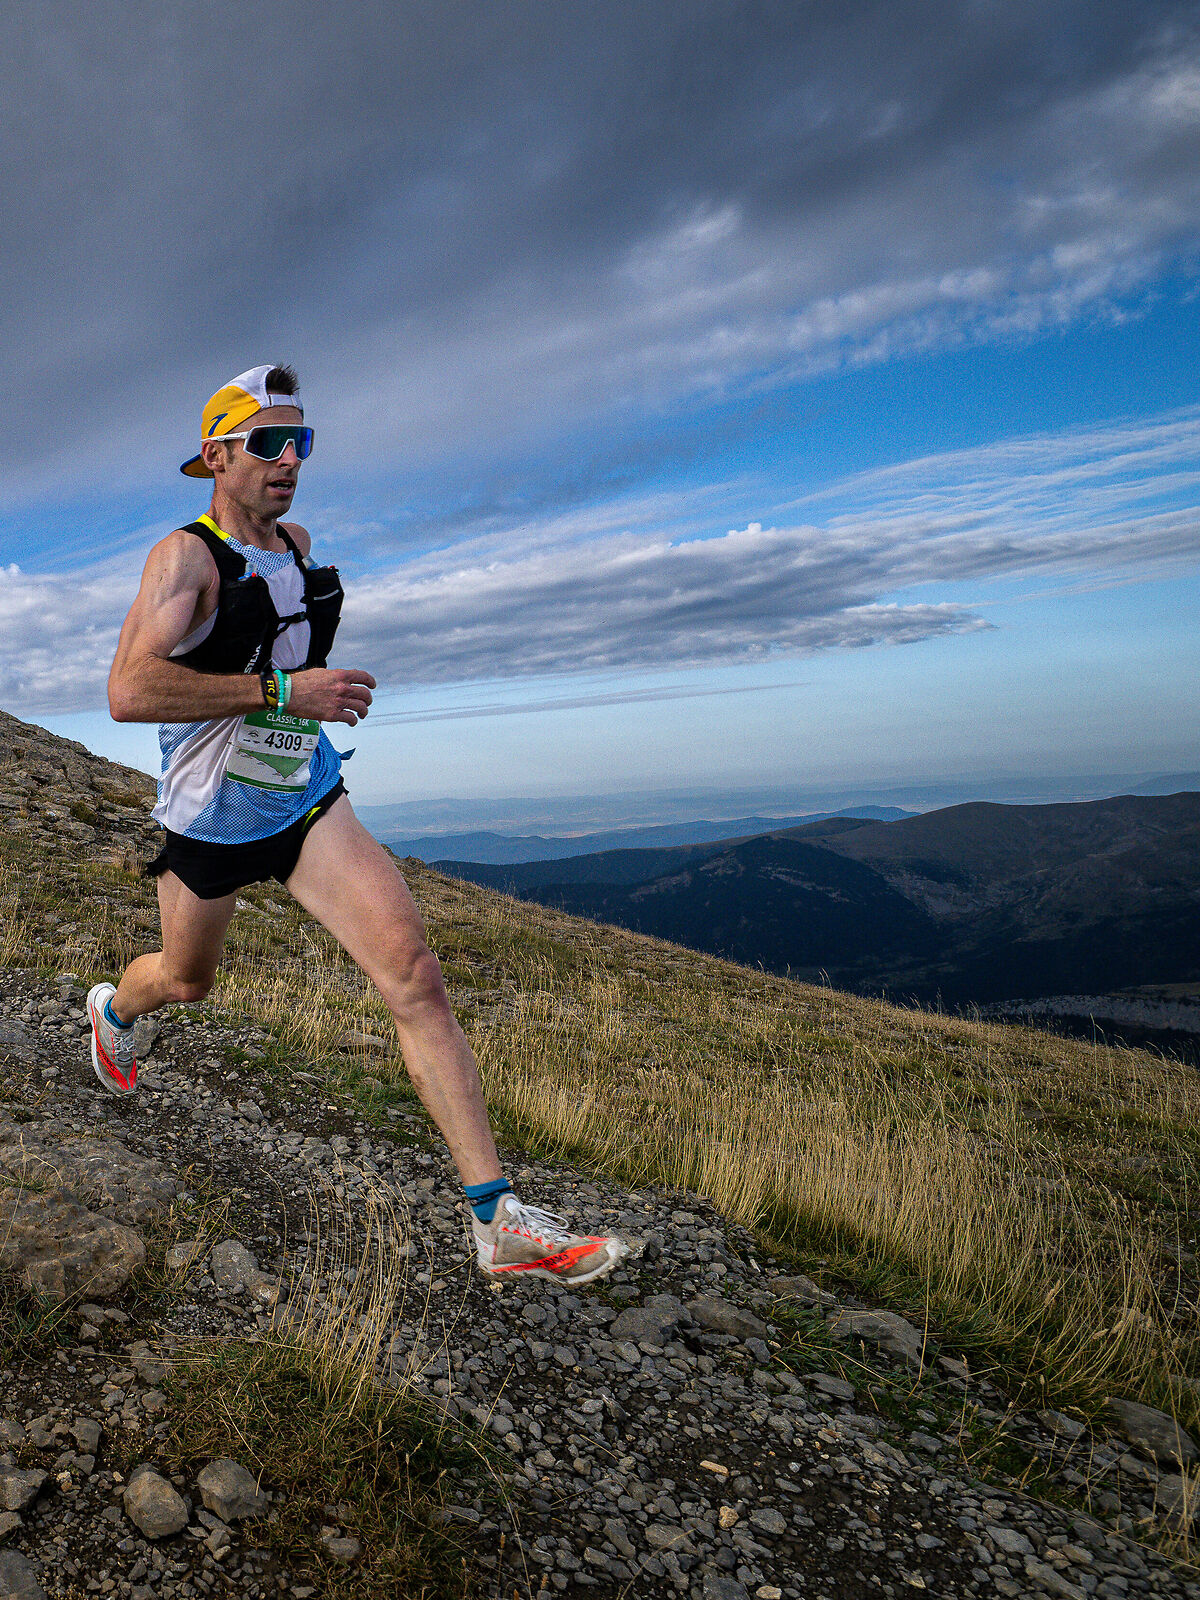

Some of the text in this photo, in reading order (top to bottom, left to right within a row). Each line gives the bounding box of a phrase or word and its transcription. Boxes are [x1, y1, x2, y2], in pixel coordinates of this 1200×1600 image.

[266, 680, 276, 694] ETC
[266, 713, 298, 725] CLASSIC
[264, 731, 302, 751] 4309
